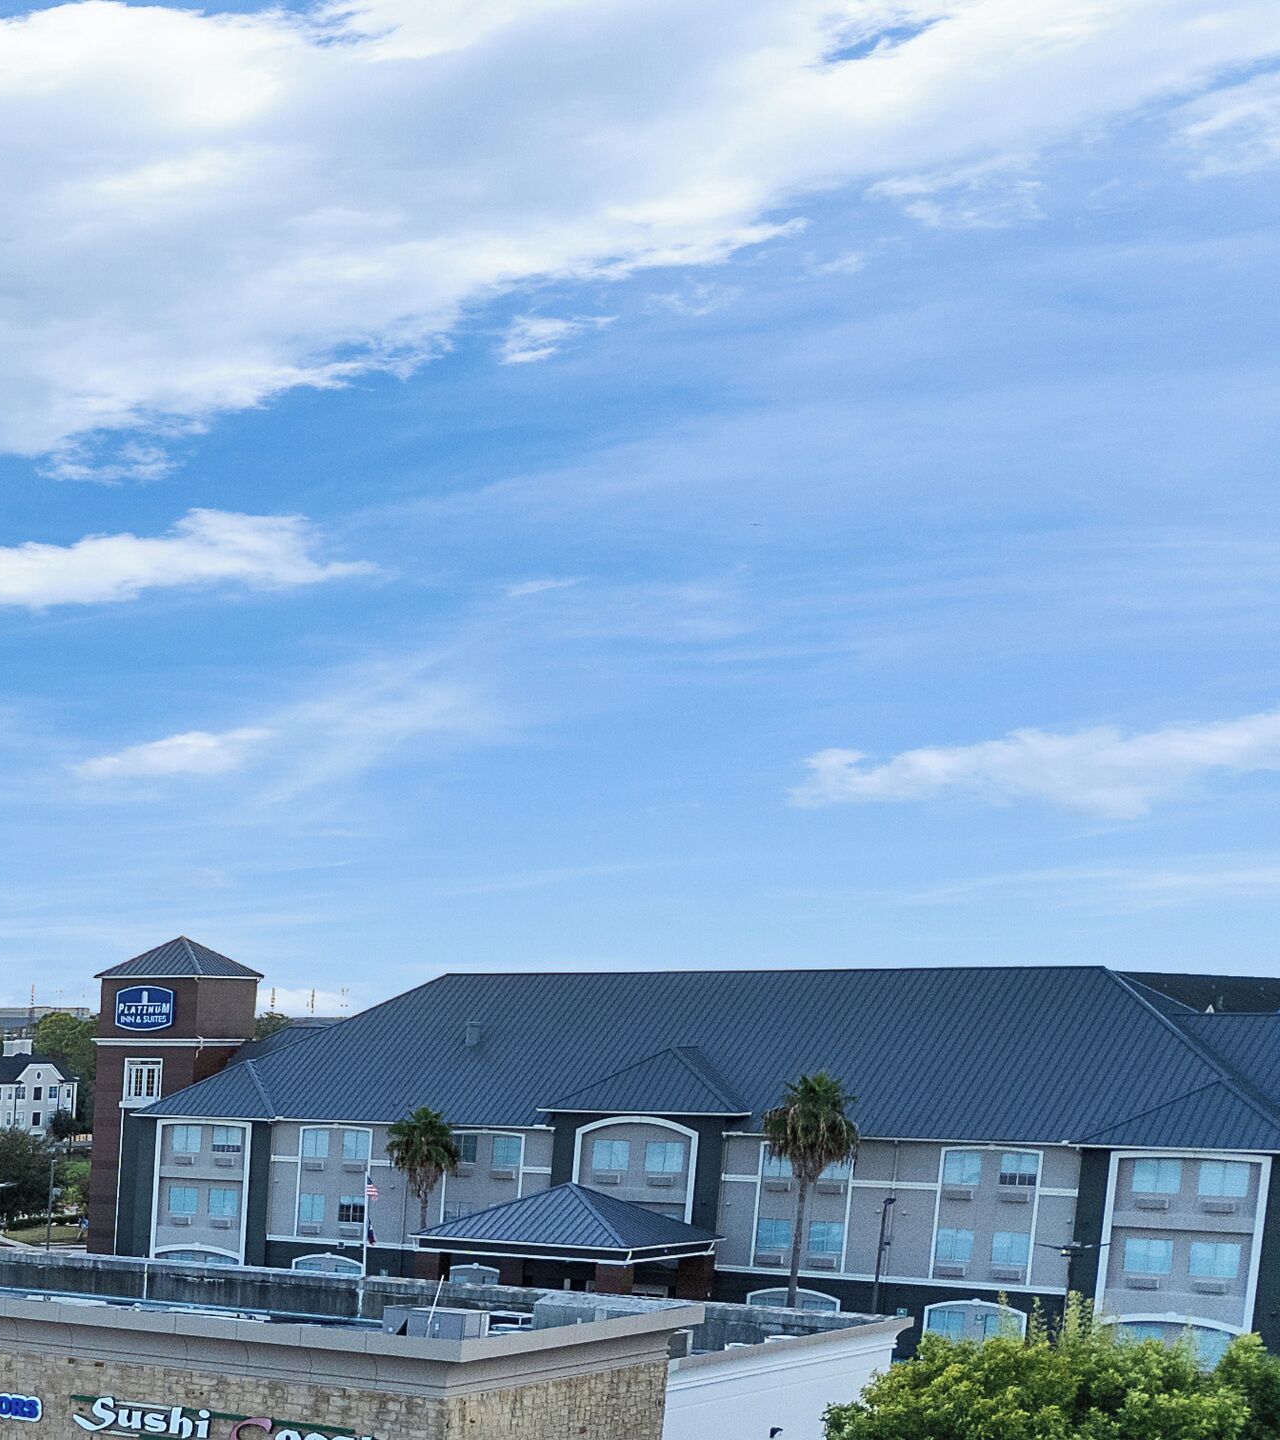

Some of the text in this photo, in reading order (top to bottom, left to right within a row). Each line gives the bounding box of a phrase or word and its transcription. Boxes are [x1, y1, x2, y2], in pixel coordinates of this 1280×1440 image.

[118, 1003, 170, 1014] PLATINUM
[120, 1015, 167, 1023] INN & SUITES
[72, 1396, 211, 1439] Sushi
